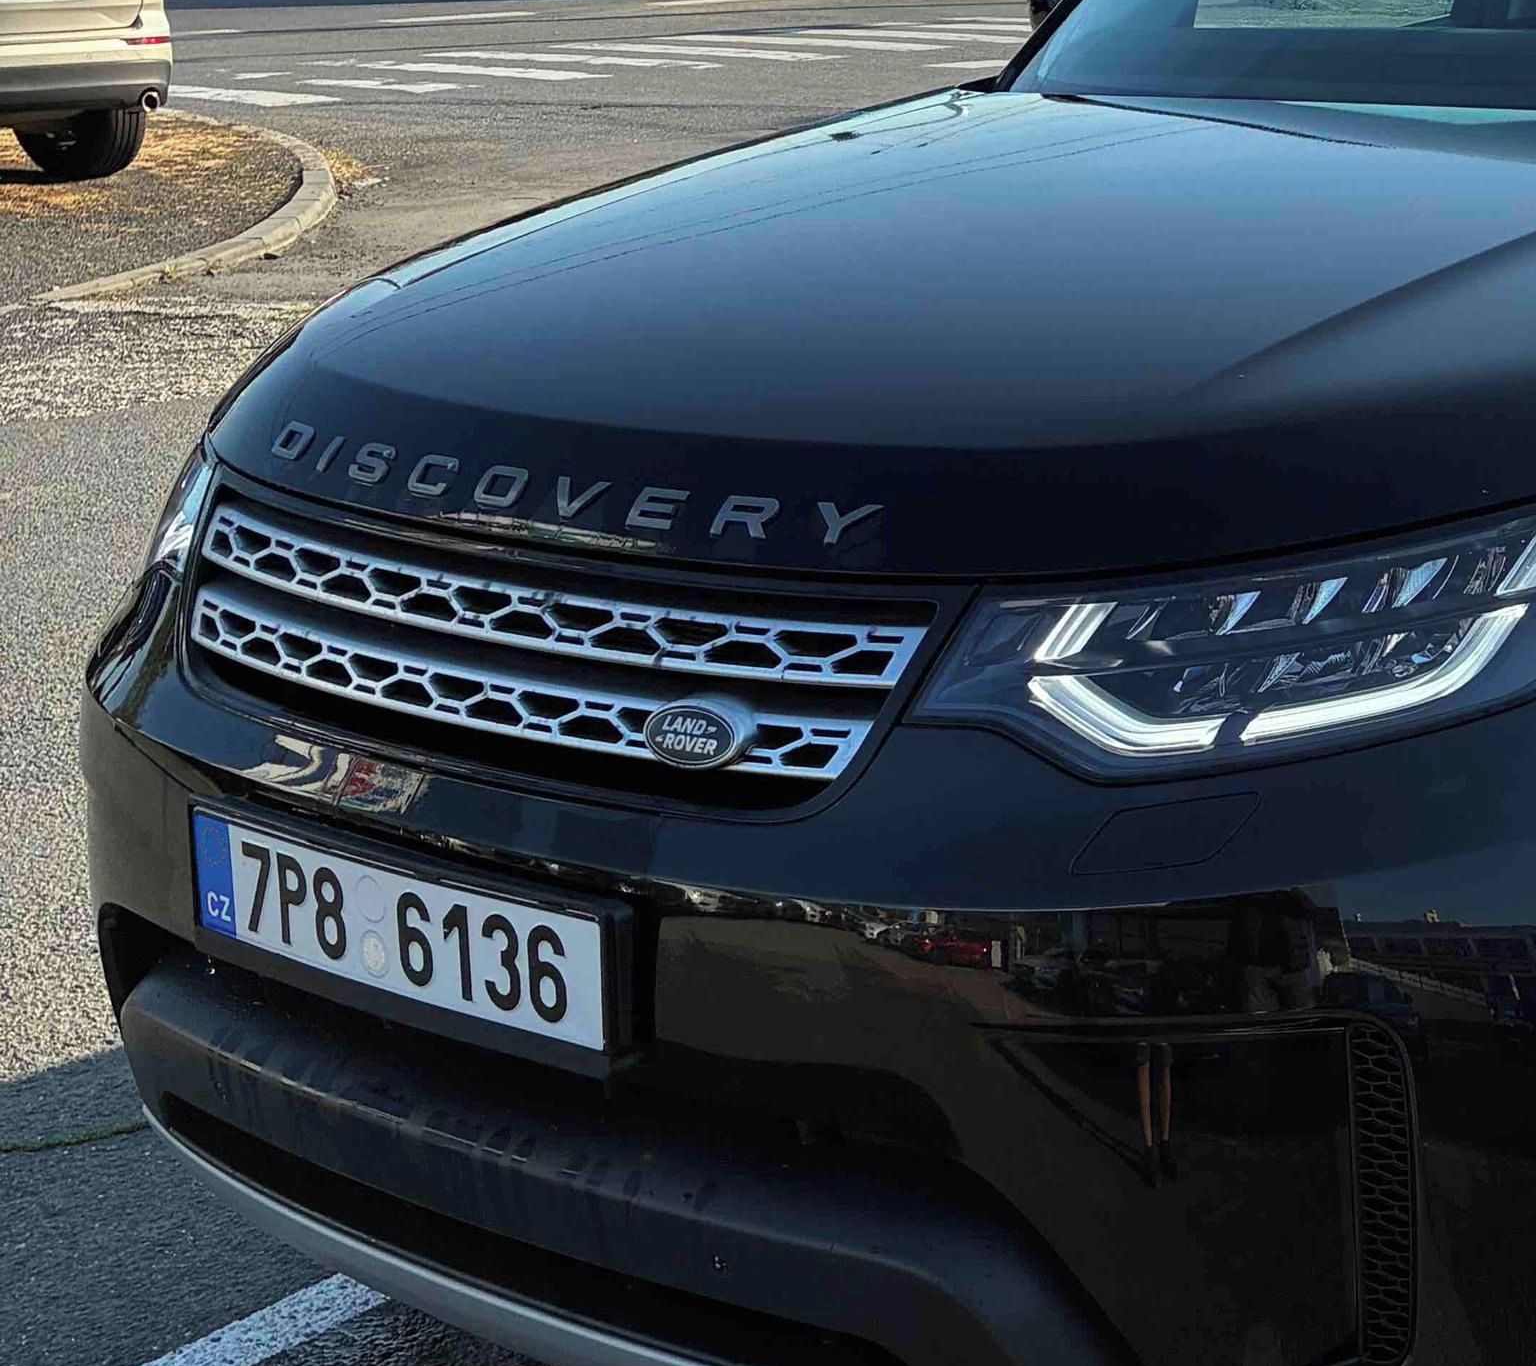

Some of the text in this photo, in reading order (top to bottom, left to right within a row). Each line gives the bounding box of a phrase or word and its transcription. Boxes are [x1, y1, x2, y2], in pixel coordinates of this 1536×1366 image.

[270, 420, 884, 545] DISCOVERY
[662, 715, 707, 735] LAND
[663, 732, 718, 755] ROVER
[206, 890, 232, 923] CZ
[241, 839, 568, 1024] 7P8 6136
